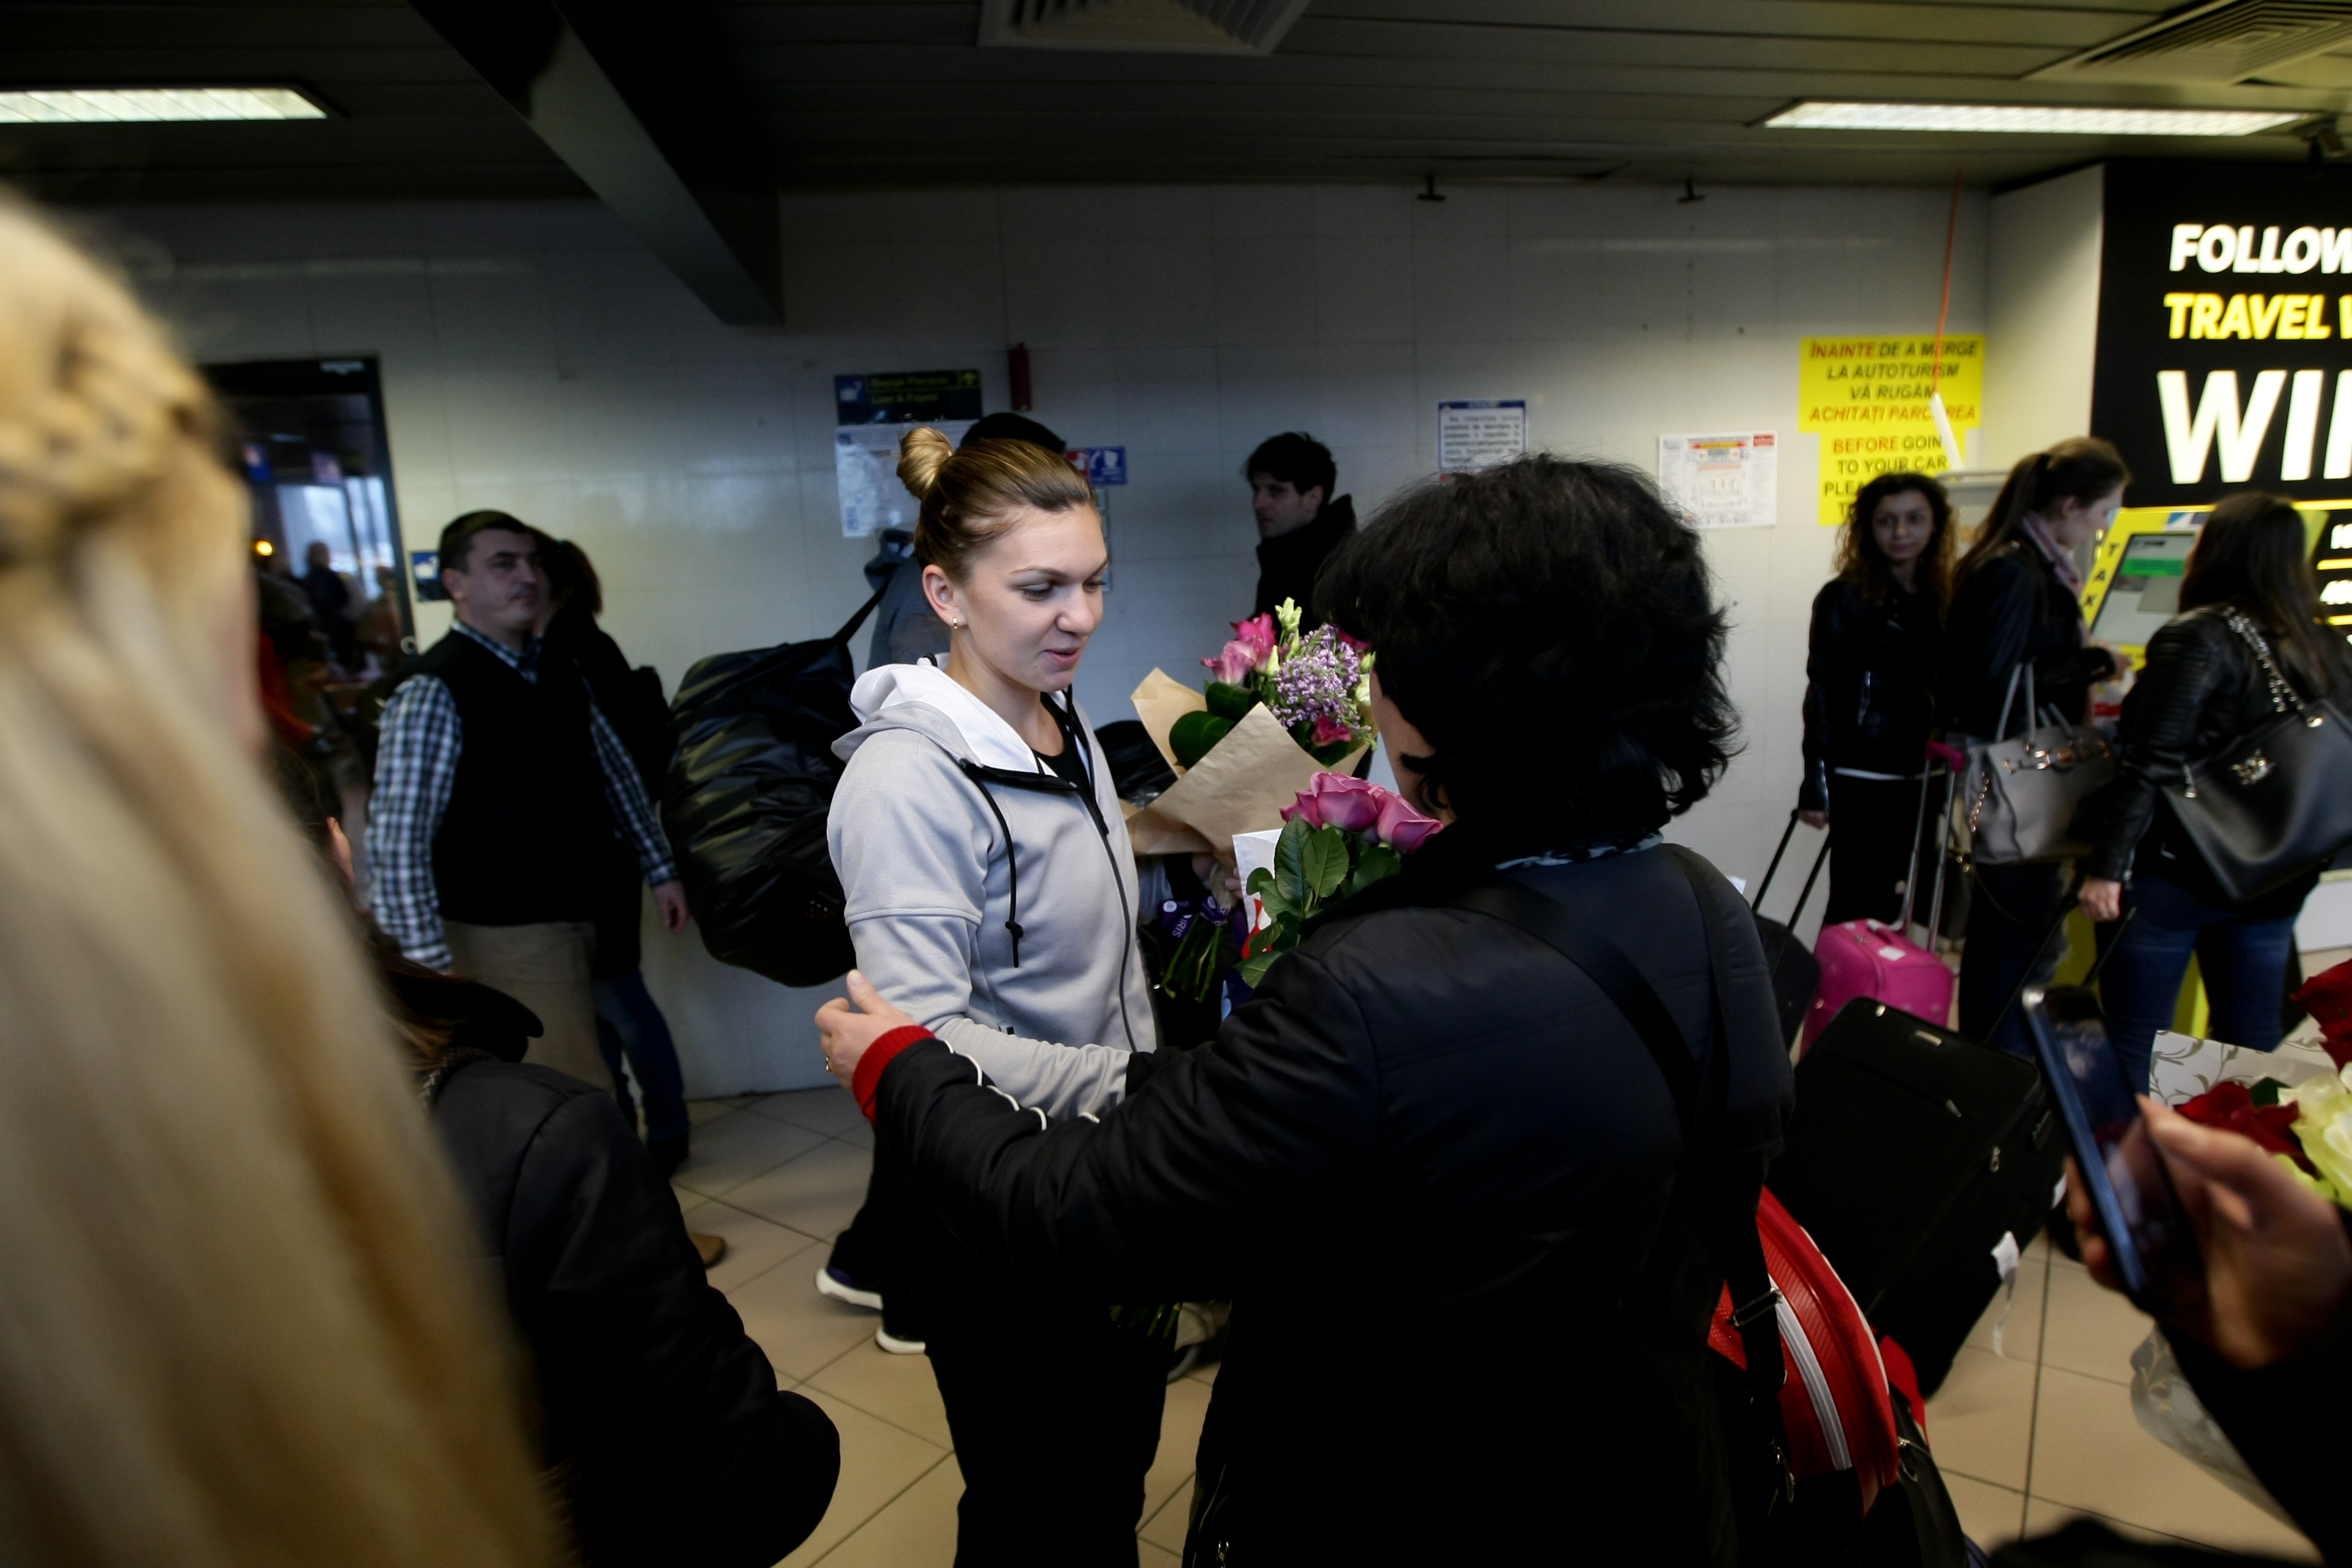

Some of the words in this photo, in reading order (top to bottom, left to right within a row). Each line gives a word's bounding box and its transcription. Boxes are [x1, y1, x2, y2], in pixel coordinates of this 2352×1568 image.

[2164, 293, 2331, 339] TRAVEL
[1879, 342, 1900, 356] DE
[1905, 342, 1916, 356] A
[1921, 341, 1978, 356] MRGE
[1827, 364, 1849, 380] LA
[1833, 436, 1898, 454] BEFORE
[1903, 435, 1941, 450] GOIN
[1837, 459, 1859, 474] TO
[1864, 456, 1909, 473] YOUR
[1914, 454, 1946, 470] CAR
[1171, 918, 1188, 938] IRIS
